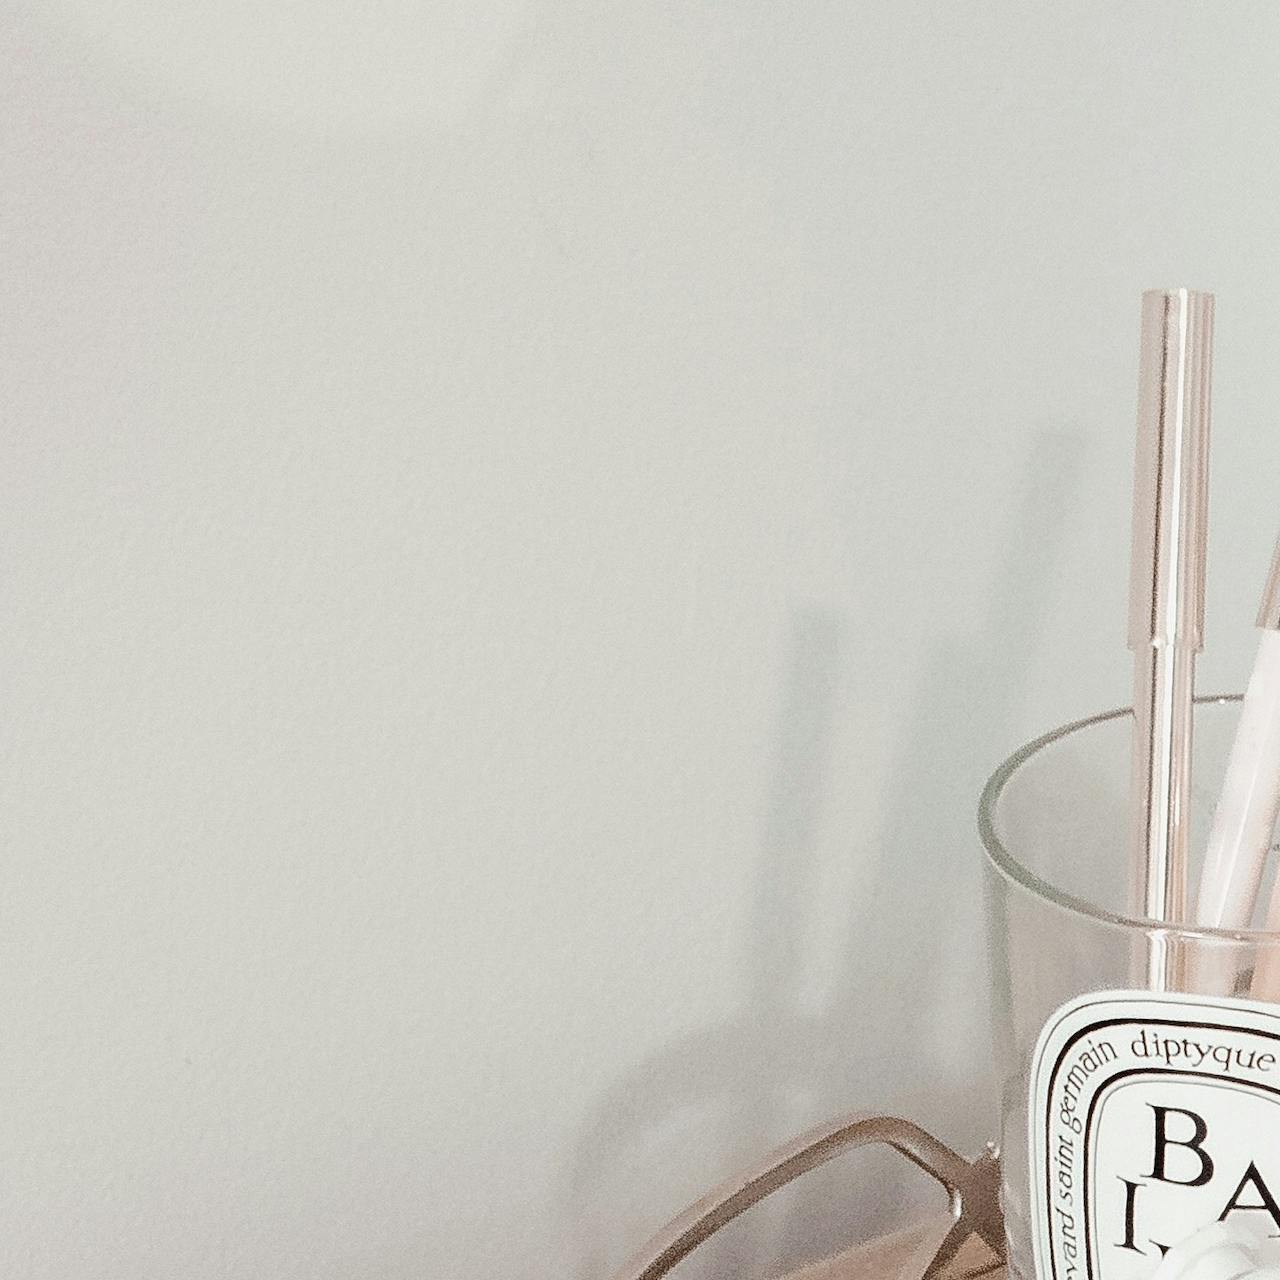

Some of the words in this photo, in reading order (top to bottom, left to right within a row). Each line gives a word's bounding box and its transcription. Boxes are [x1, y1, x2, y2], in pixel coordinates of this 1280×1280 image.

[1059, 1039, 1118, 1134] germain
[1131, 1029, 1277, 1072] diptyque
[1054, 1135, 1075, 1207] saint
